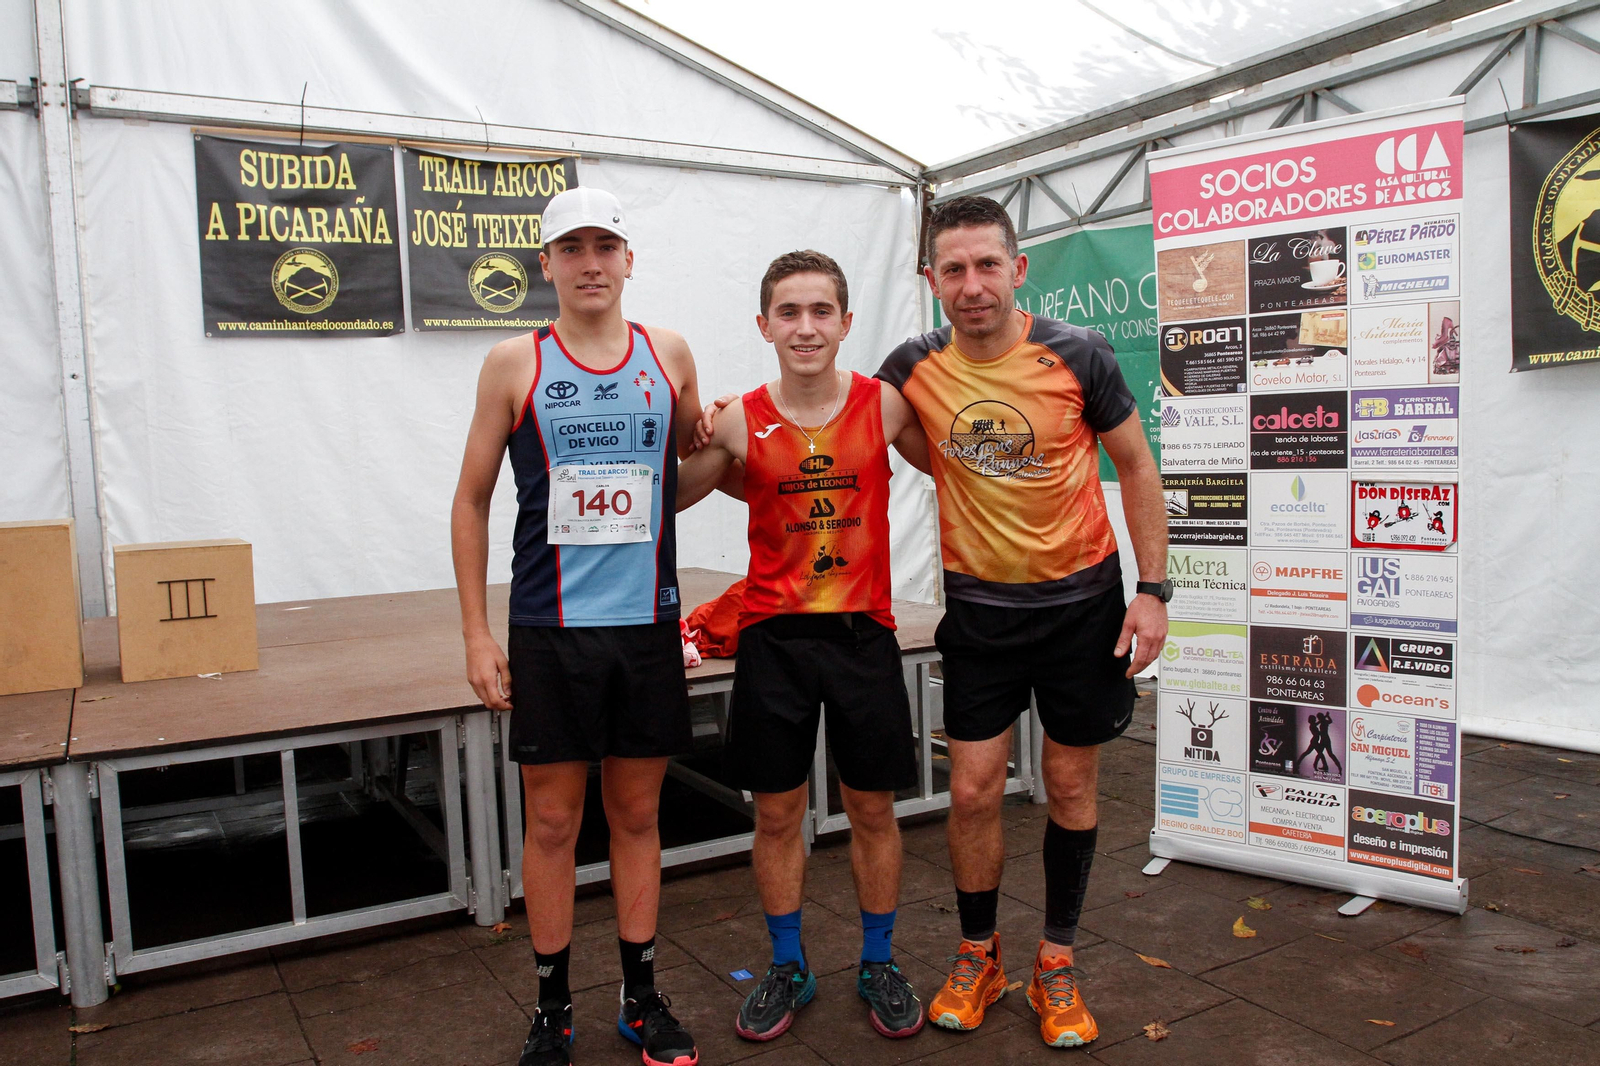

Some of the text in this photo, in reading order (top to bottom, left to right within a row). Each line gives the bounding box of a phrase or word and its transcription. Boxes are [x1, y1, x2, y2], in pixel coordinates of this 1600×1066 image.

[240, 149, 357, 190] SUBIDA
[419, 155, 566, 197] TRAIL ARCOS
[1200, 156, 1317, 199] SOCIOS
[1375, 170, 1451, 187] CASA CULTURAL
[1375, 181, 1451, 205] DE ARCOS
[1158, 183, 1367, 233] COLABORADORES
[205, 196, 392, 244] A PICARAÑA
[412, 199, 467, 248] JOSÉ
[1368, 223, 1456, 244] PÉREZ PARDO
[1250, 237, 1343, 264] La Clave
[1377, 249, 1450, 266] EUROMASTER
[1254, 276, 1300, 287] PRAZA MAIOR
[1380, 278, 1446, 291] MICHELIN
[1260, 297, 1335, 309] PONTEAREAS
[218, 319, 394, 331] www.caminhantesdocondado.es
[1380, 358, 1404, 366] Hidalgo,
[1254, 373, 1291, 386] Coveko
[1295, 373, 1329, 384] Motor,
[545, 400, 581, 409] NIPOCAR
[1184, 407, 1243, 415] CONSTRUCCIONES
[1394, 403, 1454, 416] BARRAL
[1184, 416, 1244, 428] VALE, S.L.
[1253, 405, 1339, 430] calceta
[559, 421, 625, 435] CONCELLO
[569, 436, 619, 449] DE VIGO
[1355, 447, 1455, 456] www.ferreteriabarral.es
[1162, 458, 1206, 466] Salvaterra
[1222, 457, 1243, 465] Miño
[781, 478, 854, 491] HIJOS de LEONOR
[1206, 478, 1244, 486] BARGIELA
[1358, 486, 1451, 501] DON DISFRAZ
[572, 489, 632, 516] 140
[1271, 502, 1325, 512] ecocelta
[786, 521, 817, 533] ALONSO
[819, 521, 824, 529] &
[826, 517, 861, 529] SERODIO
[1168, 555, 1229, 576] Mera
[1358, 557, 1400, 578] IUS
[1275, 567, 1343, 580] MAPFRE
[1203, 579, 1246, 590] Técnica
[1358, 577, 1400, 598] GAL
[1405, 589, 1453, 598] PONTEAREAS
[1399, 643, 1443, 655] GRUPO
[1260, 653, 1338, 670] ESTRADA
[1393, 660, 1450, 673] R.E.VIDEO
[1259, 664, 1338, 675] estilismo caballero
[1166, 678, 1241, 692] www.globaltea.es
[1266, 675, 1325, 688] 986 66 04 63
[1267, 688, 1324, 701] PONTEAREAS
[1382, 693, 1449, 709] ocean's
[1184, 747, 1220, 762] NITIDA
[1351, 743, 1410, 758] SAN MIGUEL
[1162, 767, 1187, 776] GRUPO
[1200, 772, 1241, 784] EMPRESAS
[1285, 788, 1337, 801] PAUTA
[1285, 795, 1340, 807] GROUP
[1261, 806, 1335, 823] MECANICA ELECTRICIDAD
[1352, 806, 1450, 836] aceroplus
[1161, 819, 1188, 829] REGINO
[1190, 823, 1225, 836] GIRALDEZ
[1272, 817, 1323, 831] COMPRA VENTA
[1282, 829, 1312, 839] CAFETERÍA
[1265, 838, 1298, 850] 986 650035
[1354, 833, 1387, 847] deseño
[1399, 840, 1448, 859] impresión
[1350, 851, 1449, 875] www.aceroplusdigital.com
